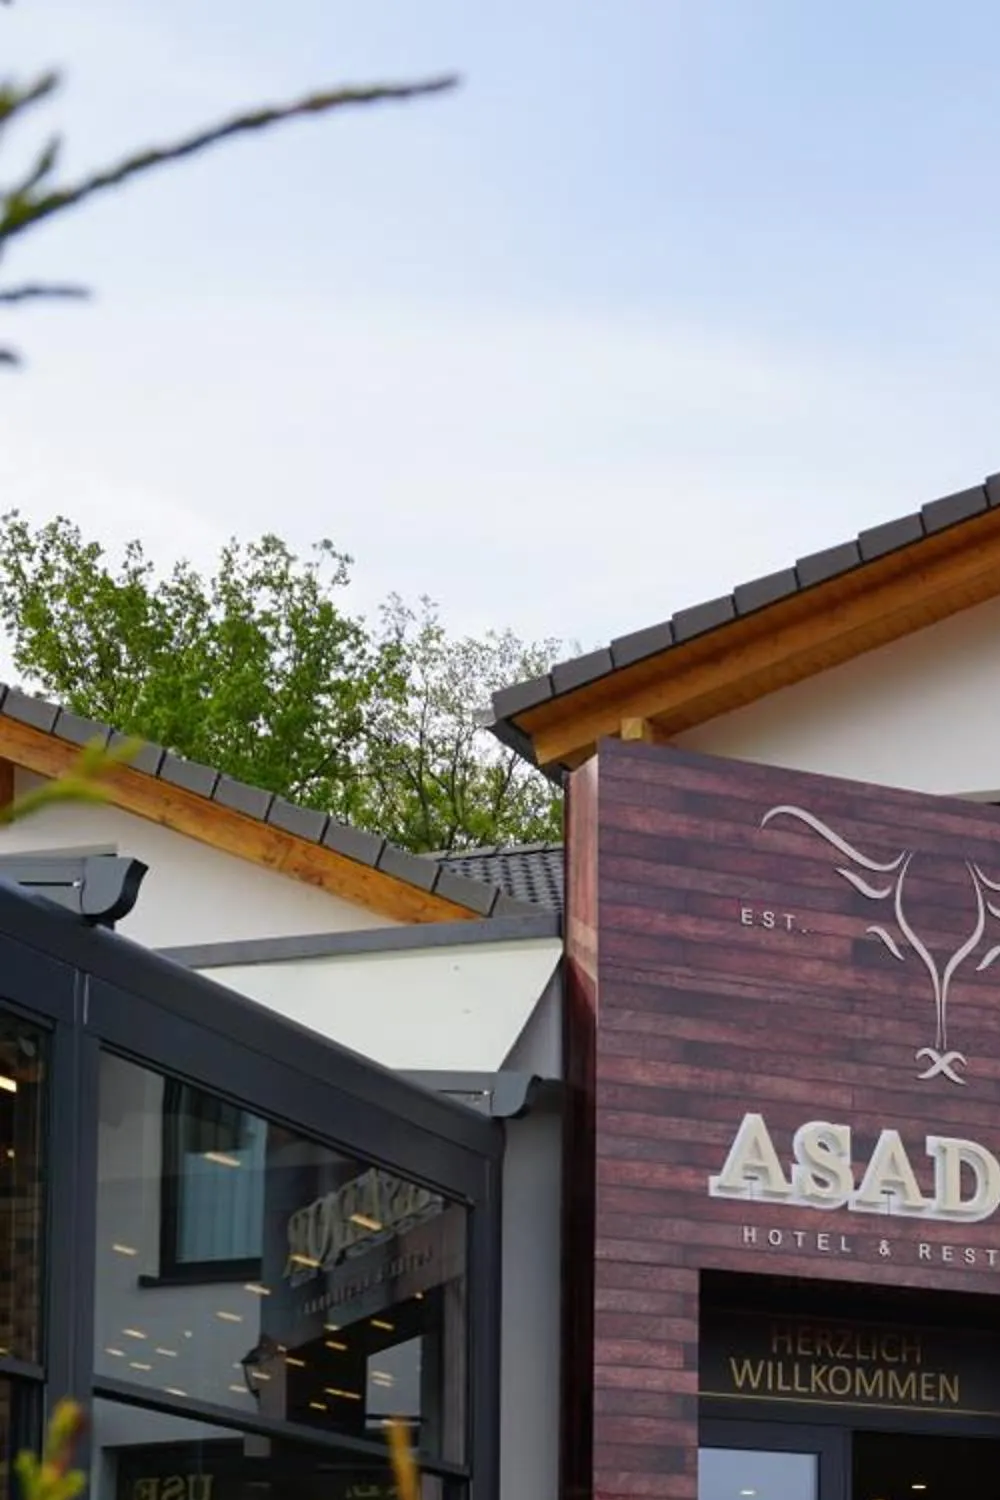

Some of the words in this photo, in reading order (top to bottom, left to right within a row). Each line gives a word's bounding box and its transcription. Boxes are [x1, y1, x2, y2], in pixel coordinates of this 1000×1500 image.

[740, 907, 810, 934] EST.
[743, 1226, 854, 1253] HOTEL
[878, 1239, 891, 1257] &
[770, 1324, 923, 1365] HERZLICH
[729, 1356, 960, 1404] WILLKOMMEN
